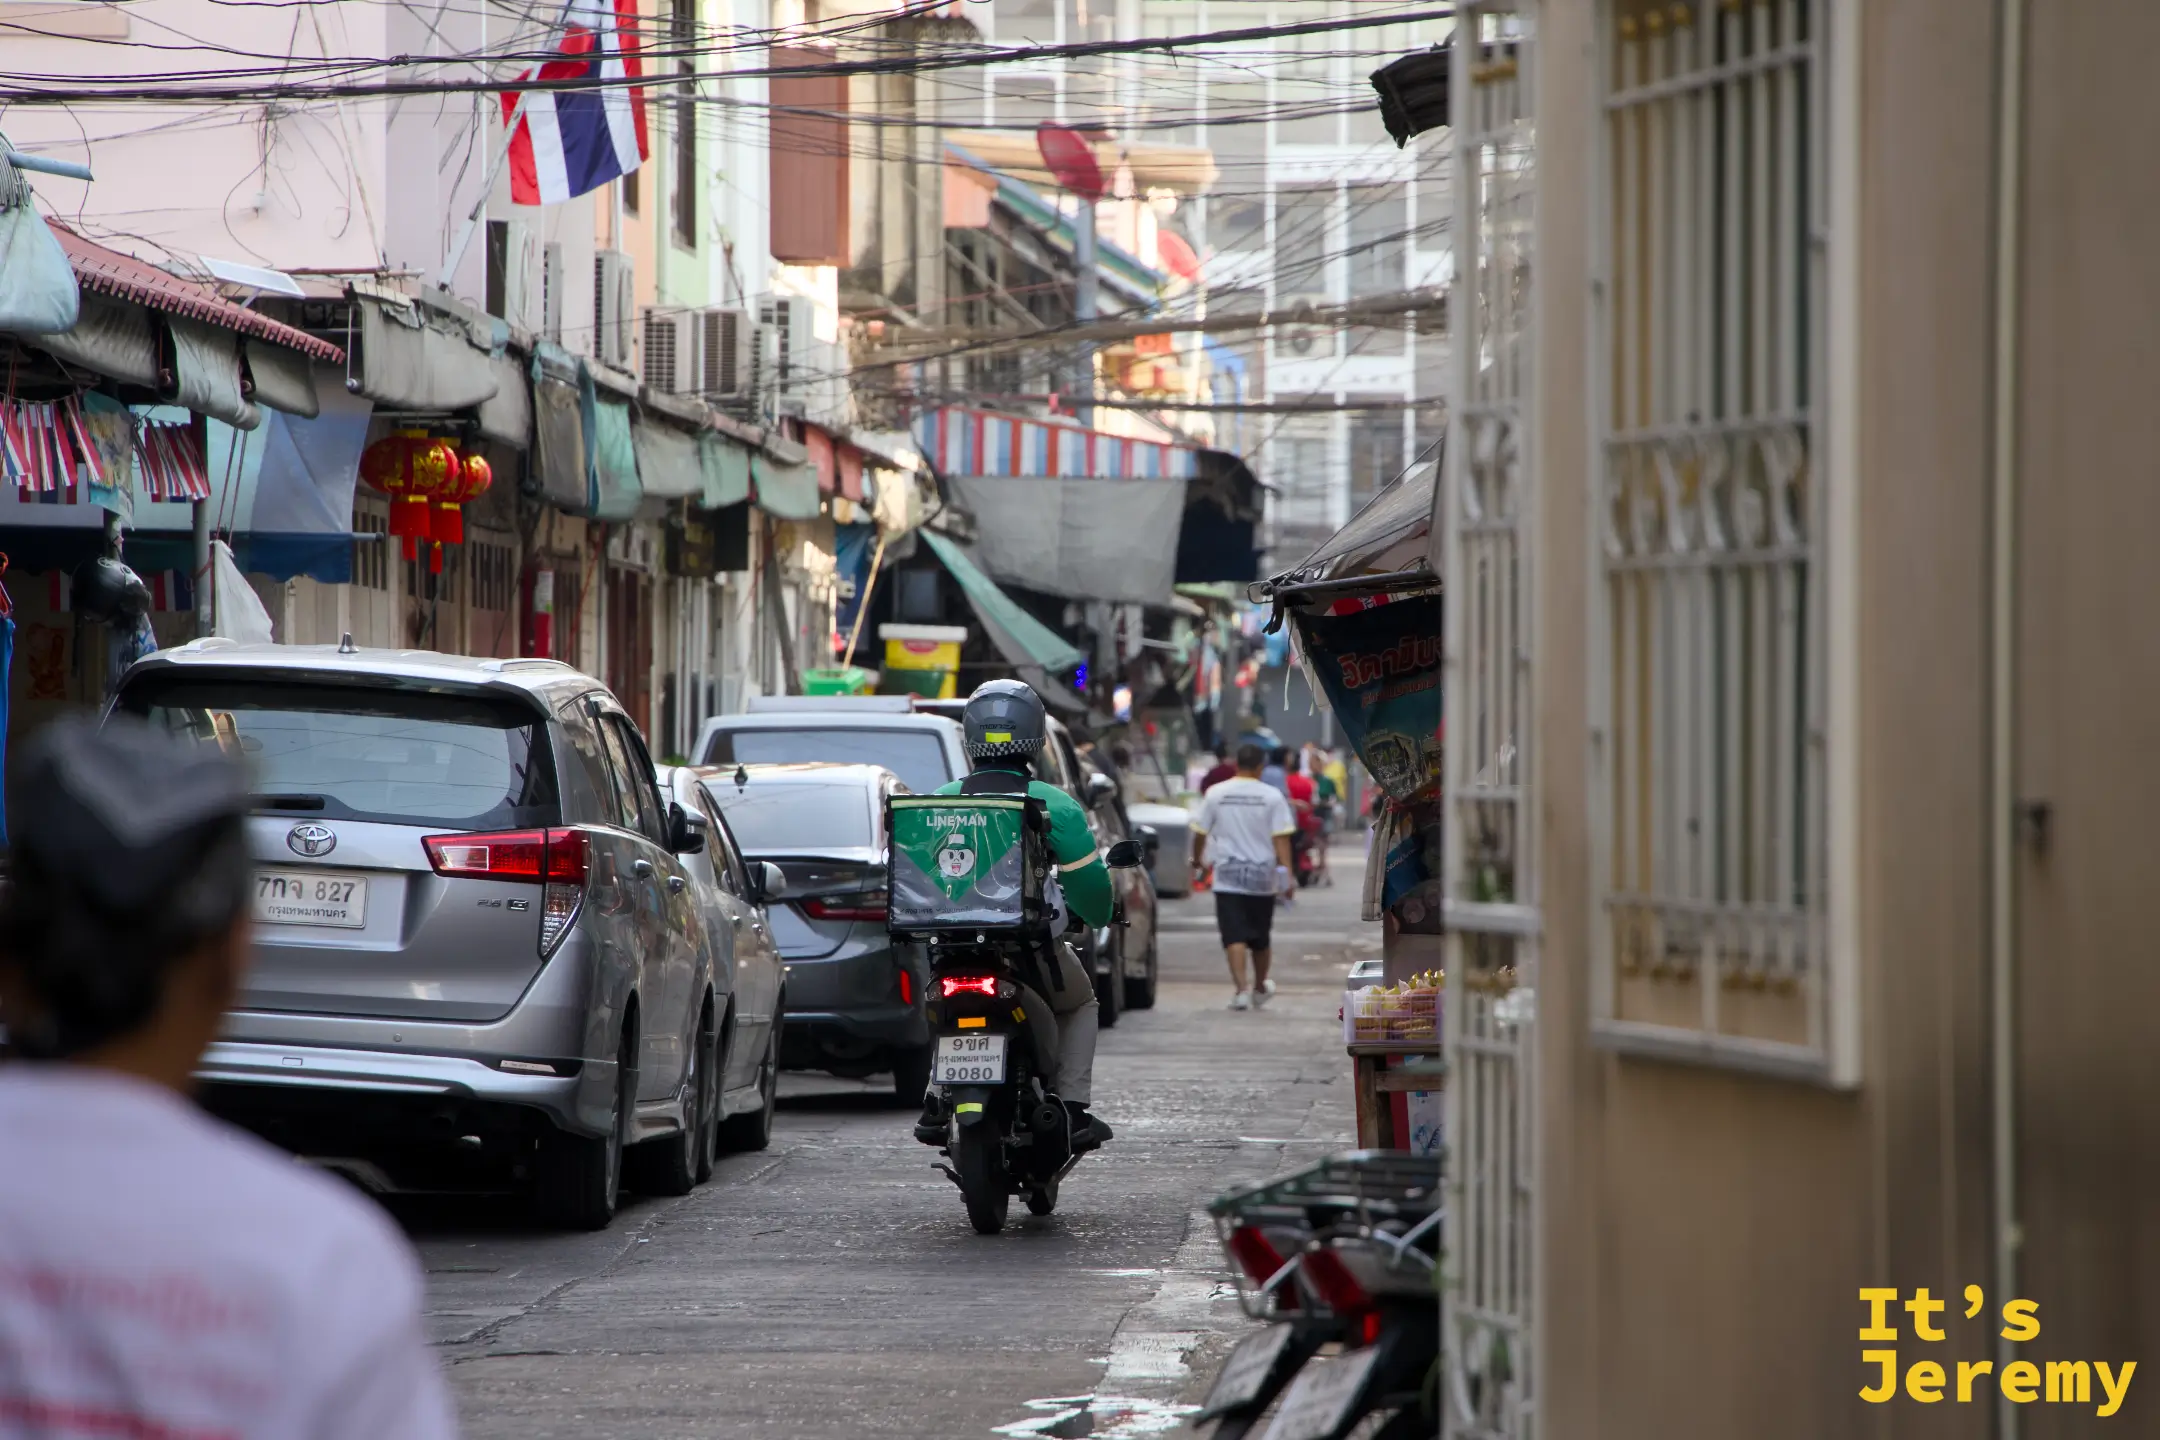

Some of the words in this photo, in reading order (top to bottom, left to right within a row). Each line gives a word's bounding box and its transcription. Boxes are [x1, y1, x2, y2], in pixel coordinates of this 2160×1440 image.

[258, 877, 303, 899] 7กจ
[315, 881, 355, 903] 827
[268, 905, 347, 918] กรุงเทพมหานคร
[945, 1067, 993, 1080] 9080
